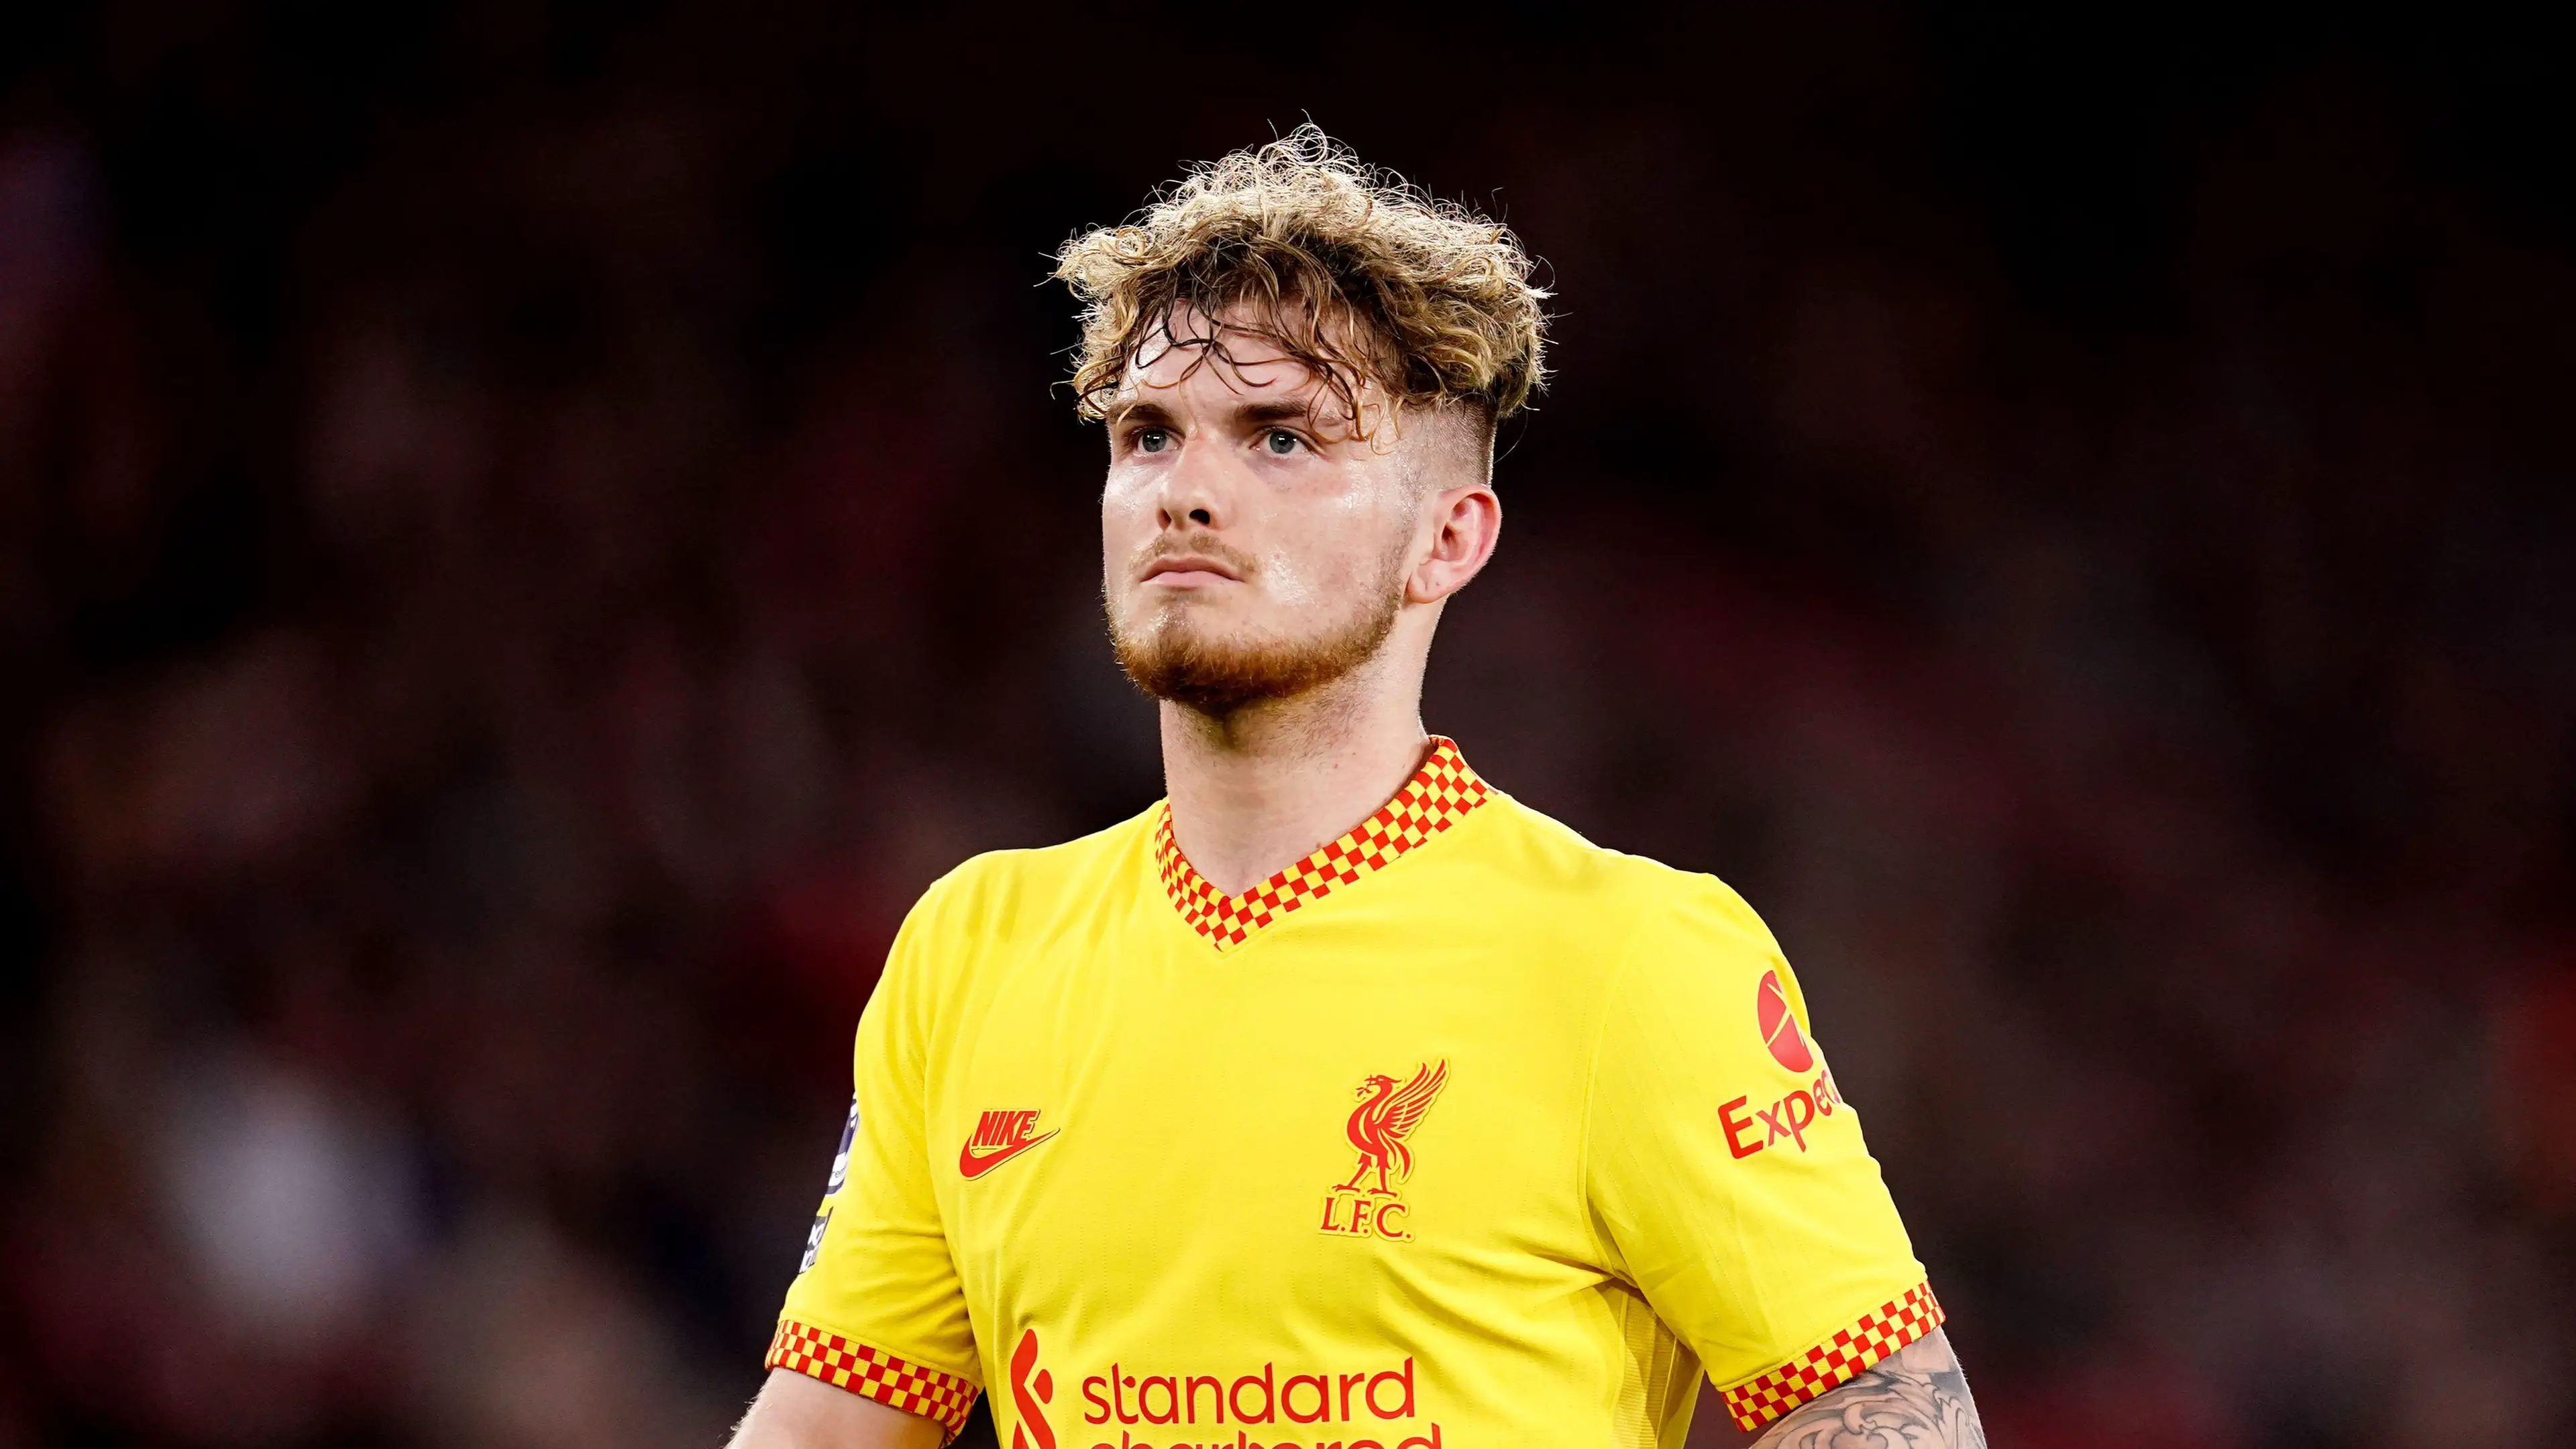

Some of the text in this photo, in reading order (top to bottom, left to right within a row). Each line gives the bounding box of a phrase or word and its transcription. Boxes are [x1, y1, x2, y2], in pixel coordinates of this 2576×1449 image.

[971, 1110, 1038, 1146] NIKE
[1320, 1197, 1411, 1238] L.F.C.
[1081, 1356, 1415, 1425] standard
